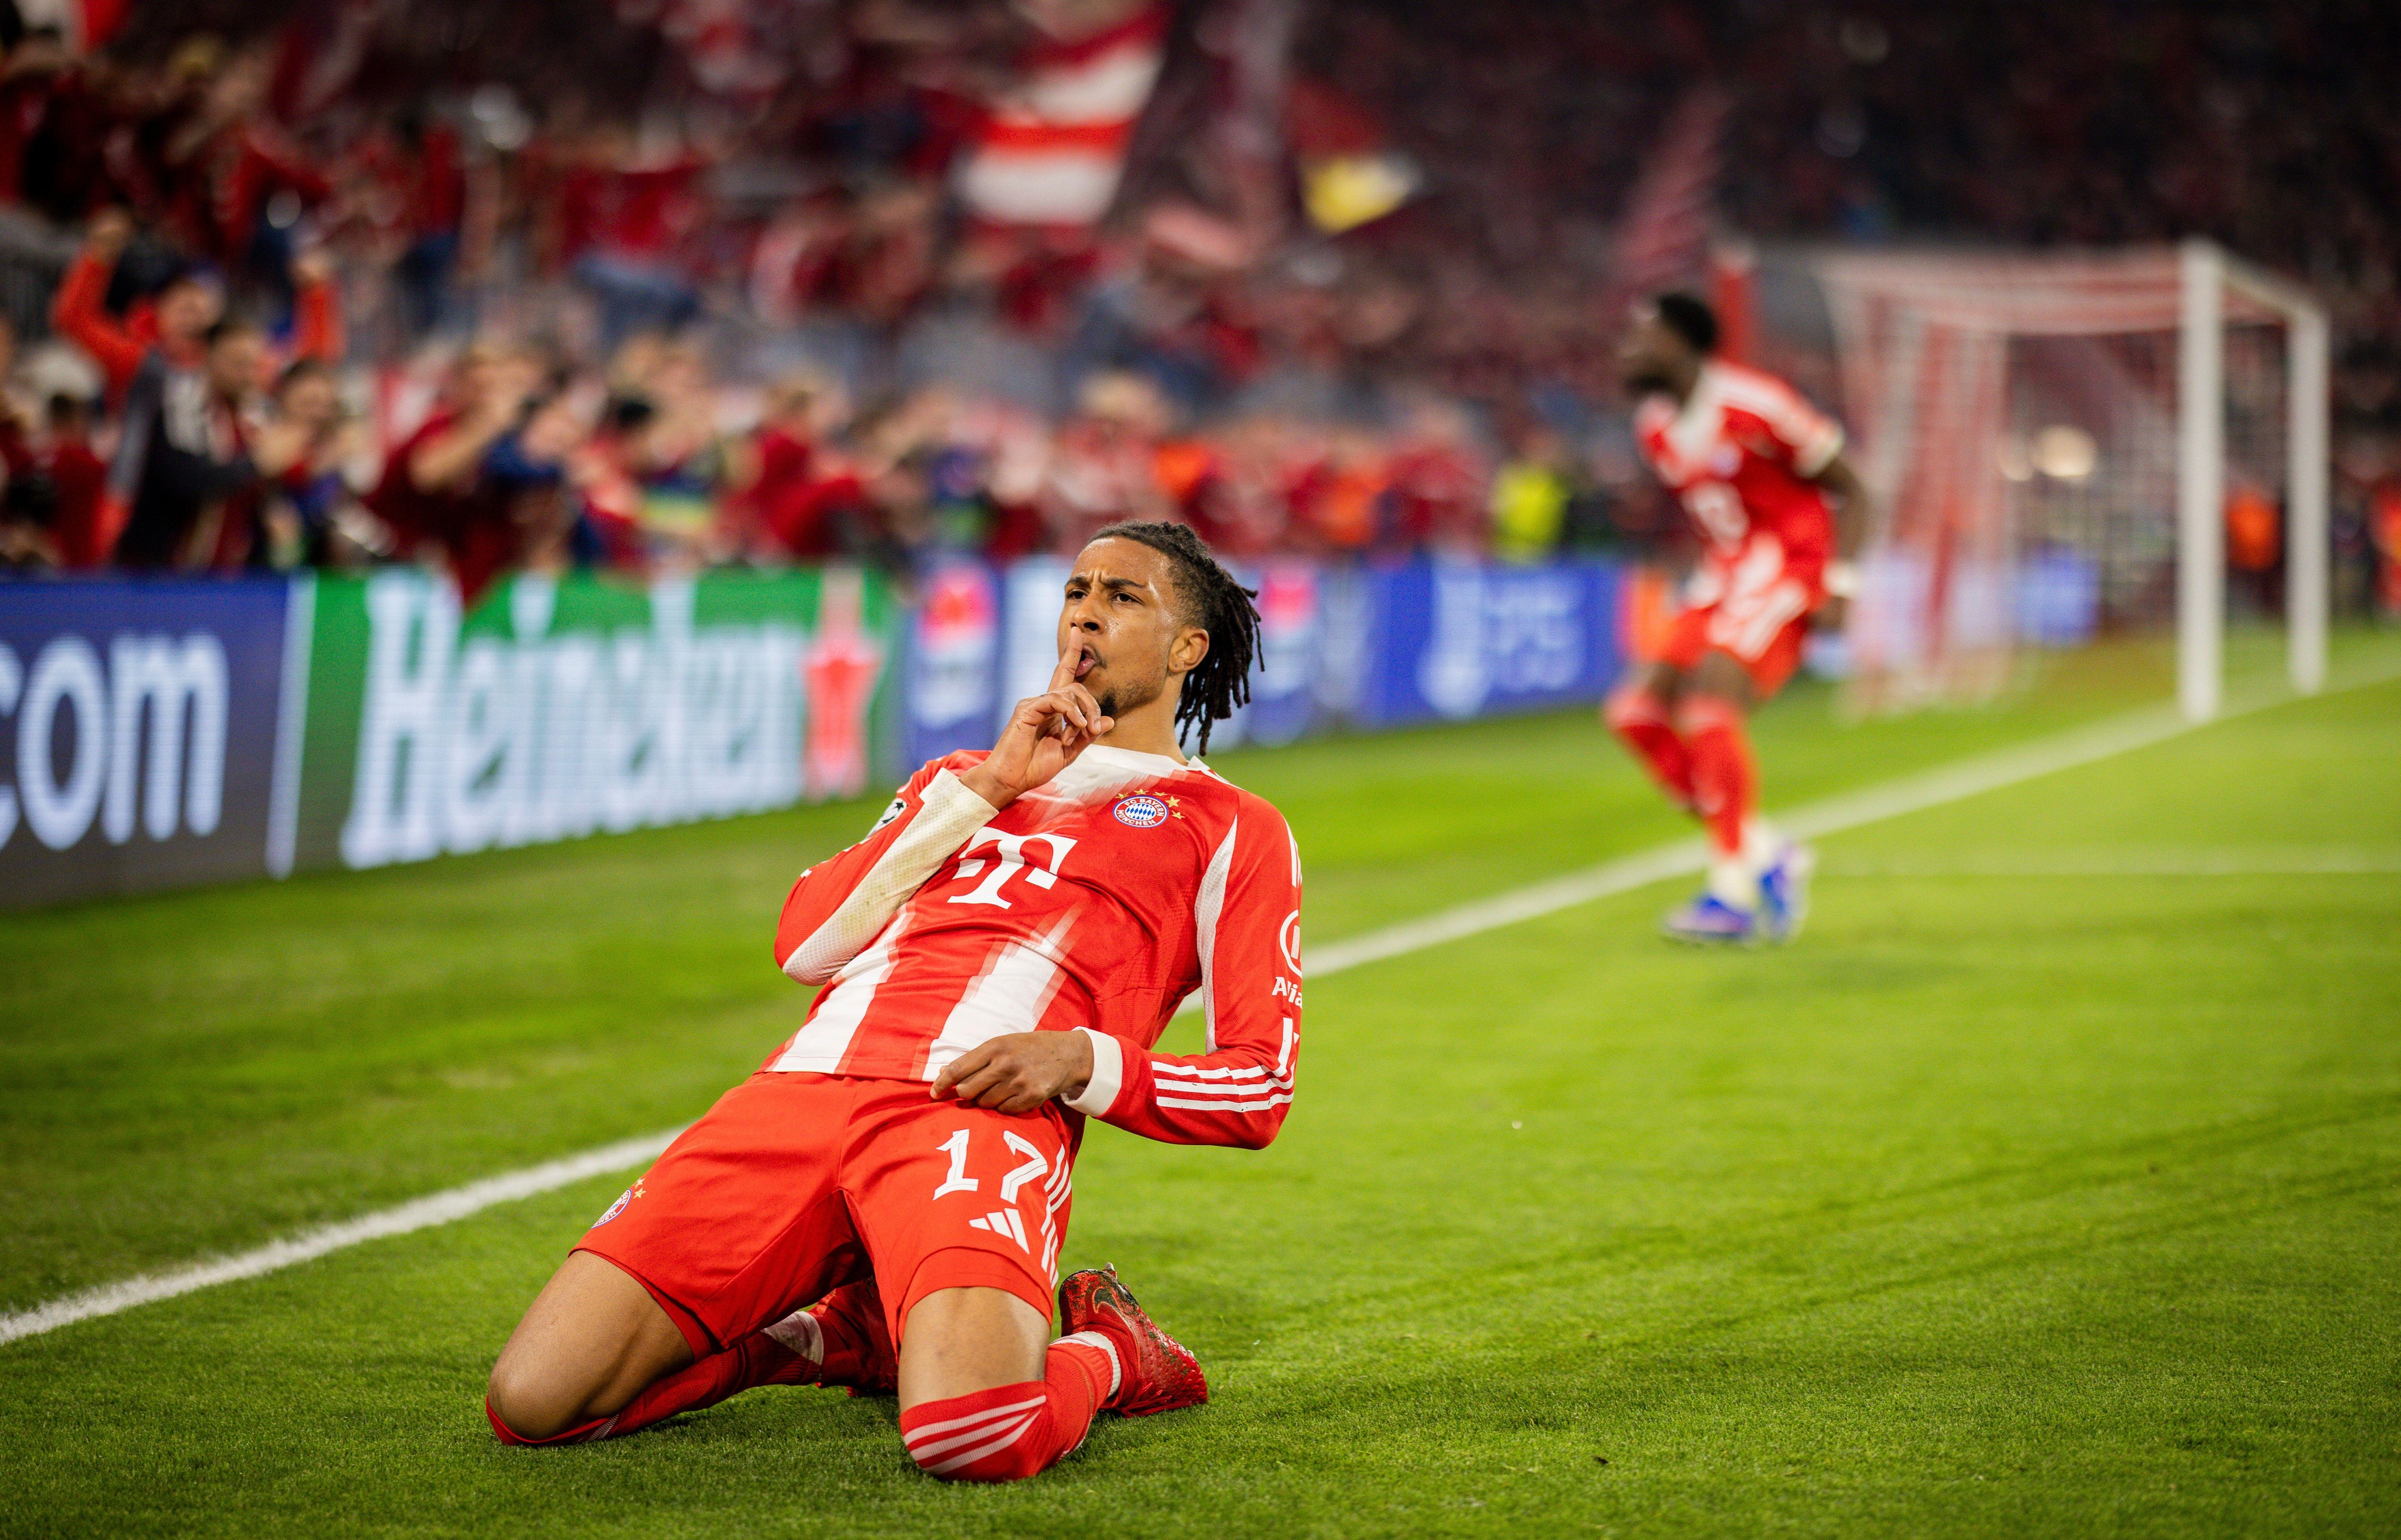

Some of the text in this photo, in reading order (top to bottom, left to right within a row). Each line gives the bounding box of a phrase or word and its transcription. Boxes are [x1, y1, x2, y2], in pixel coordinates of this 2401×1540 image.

[339, 564, 806, 871] Heineken
[1123, 798, 1165, 817] FC BAYERN
[947, 826, 1078, 910] T
[932, 1129, 1048, 1205] 17
